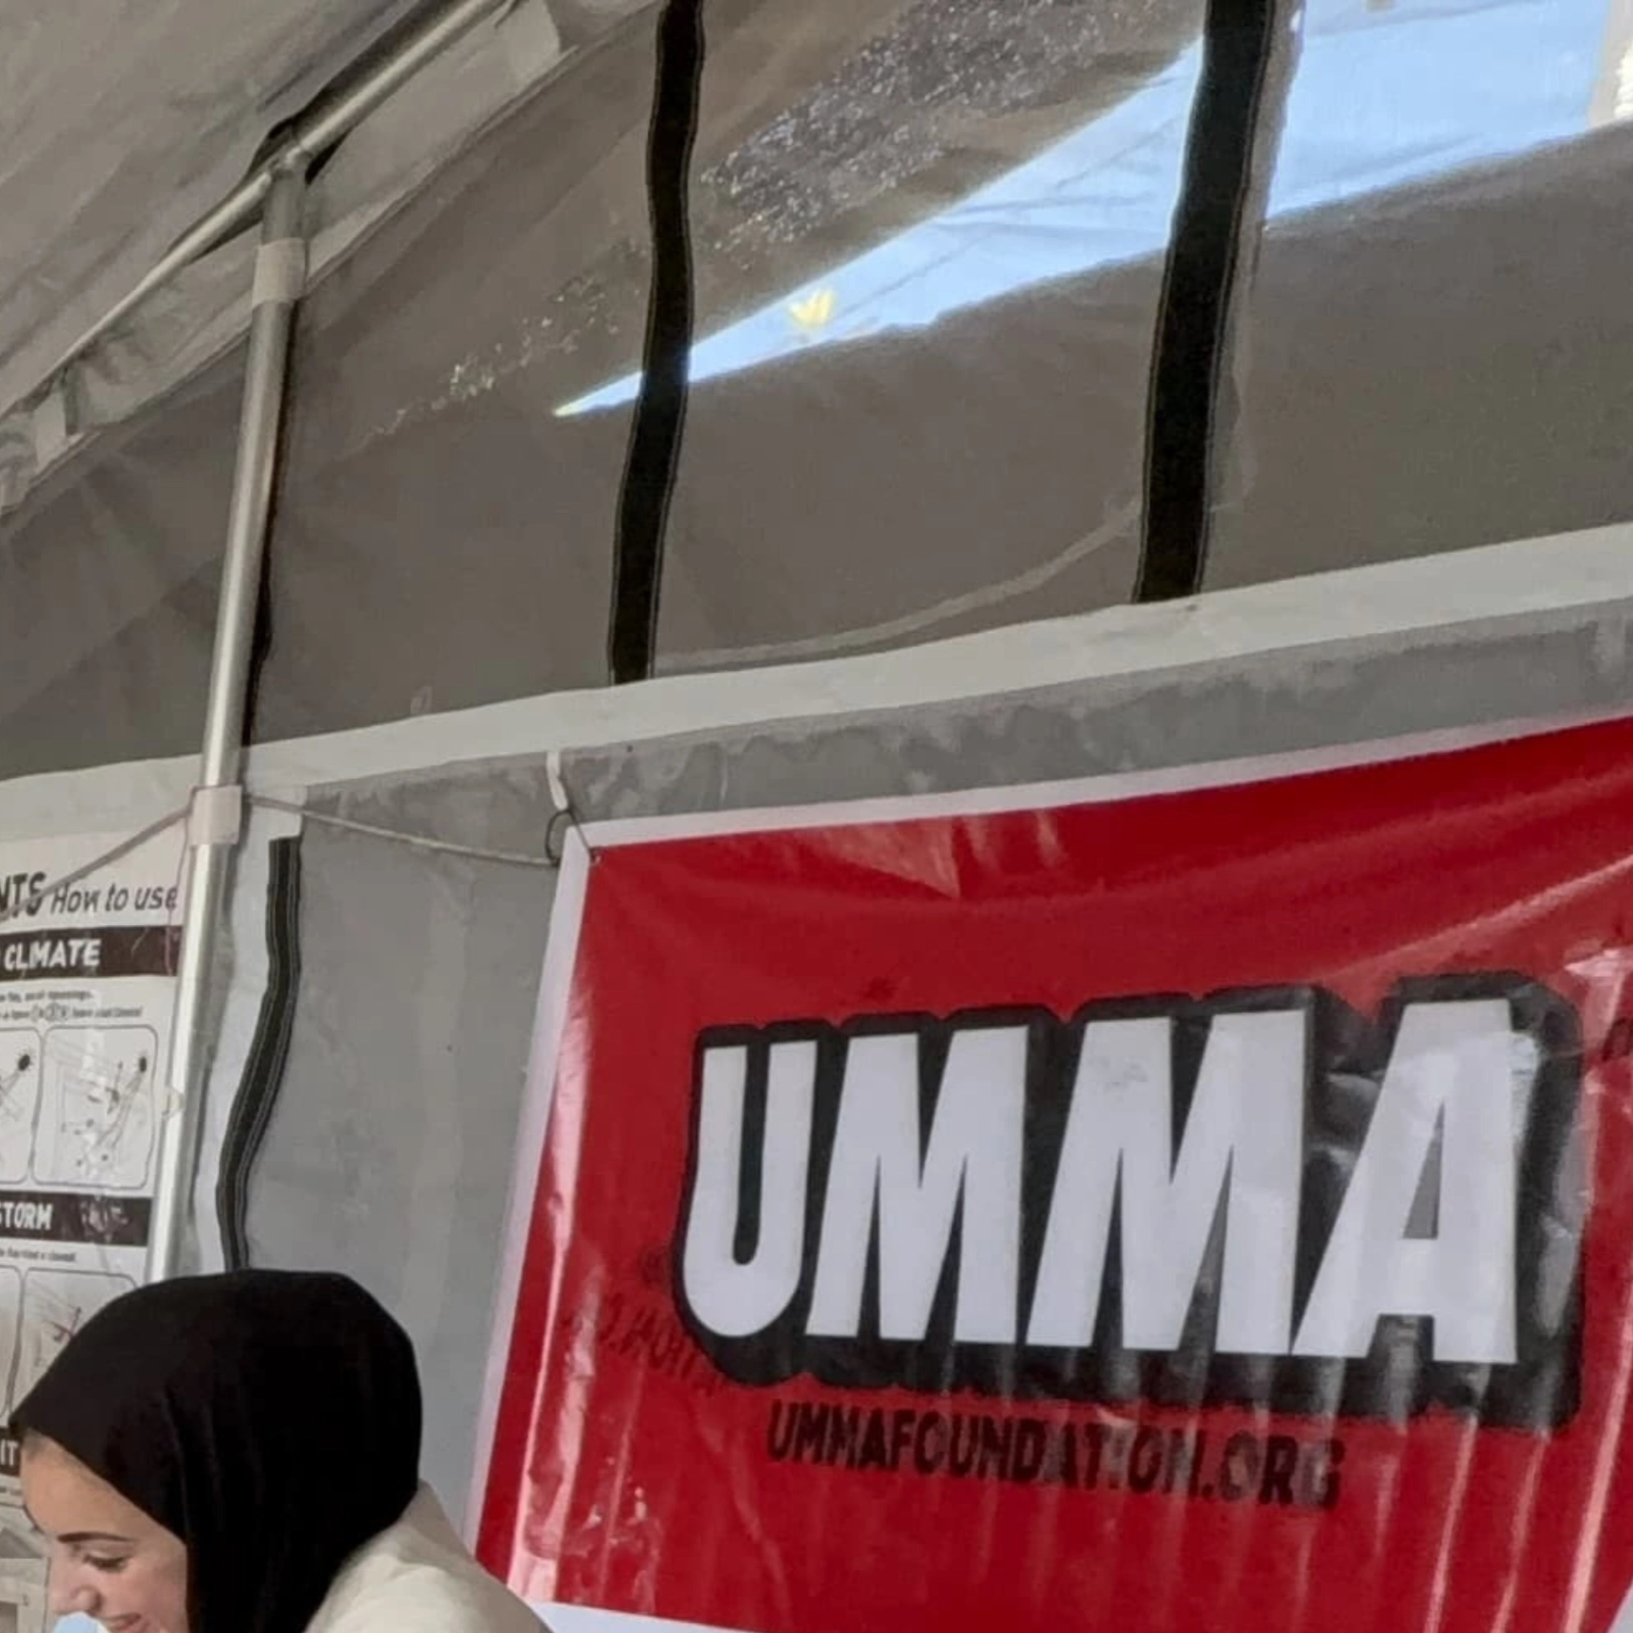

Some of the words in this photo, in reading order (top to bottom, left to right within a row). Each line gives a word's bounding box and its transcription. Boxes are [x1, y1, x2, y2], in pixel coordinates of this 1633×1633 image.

[50, 883, 101, 914] How
[105, 882, 129, 913] to
[134, 886, 178, 911] use
[682, 998, 1519, 1364] UMMA
[767, 1398, 1346, 1510] UMMAFOUNDATION.ORG
